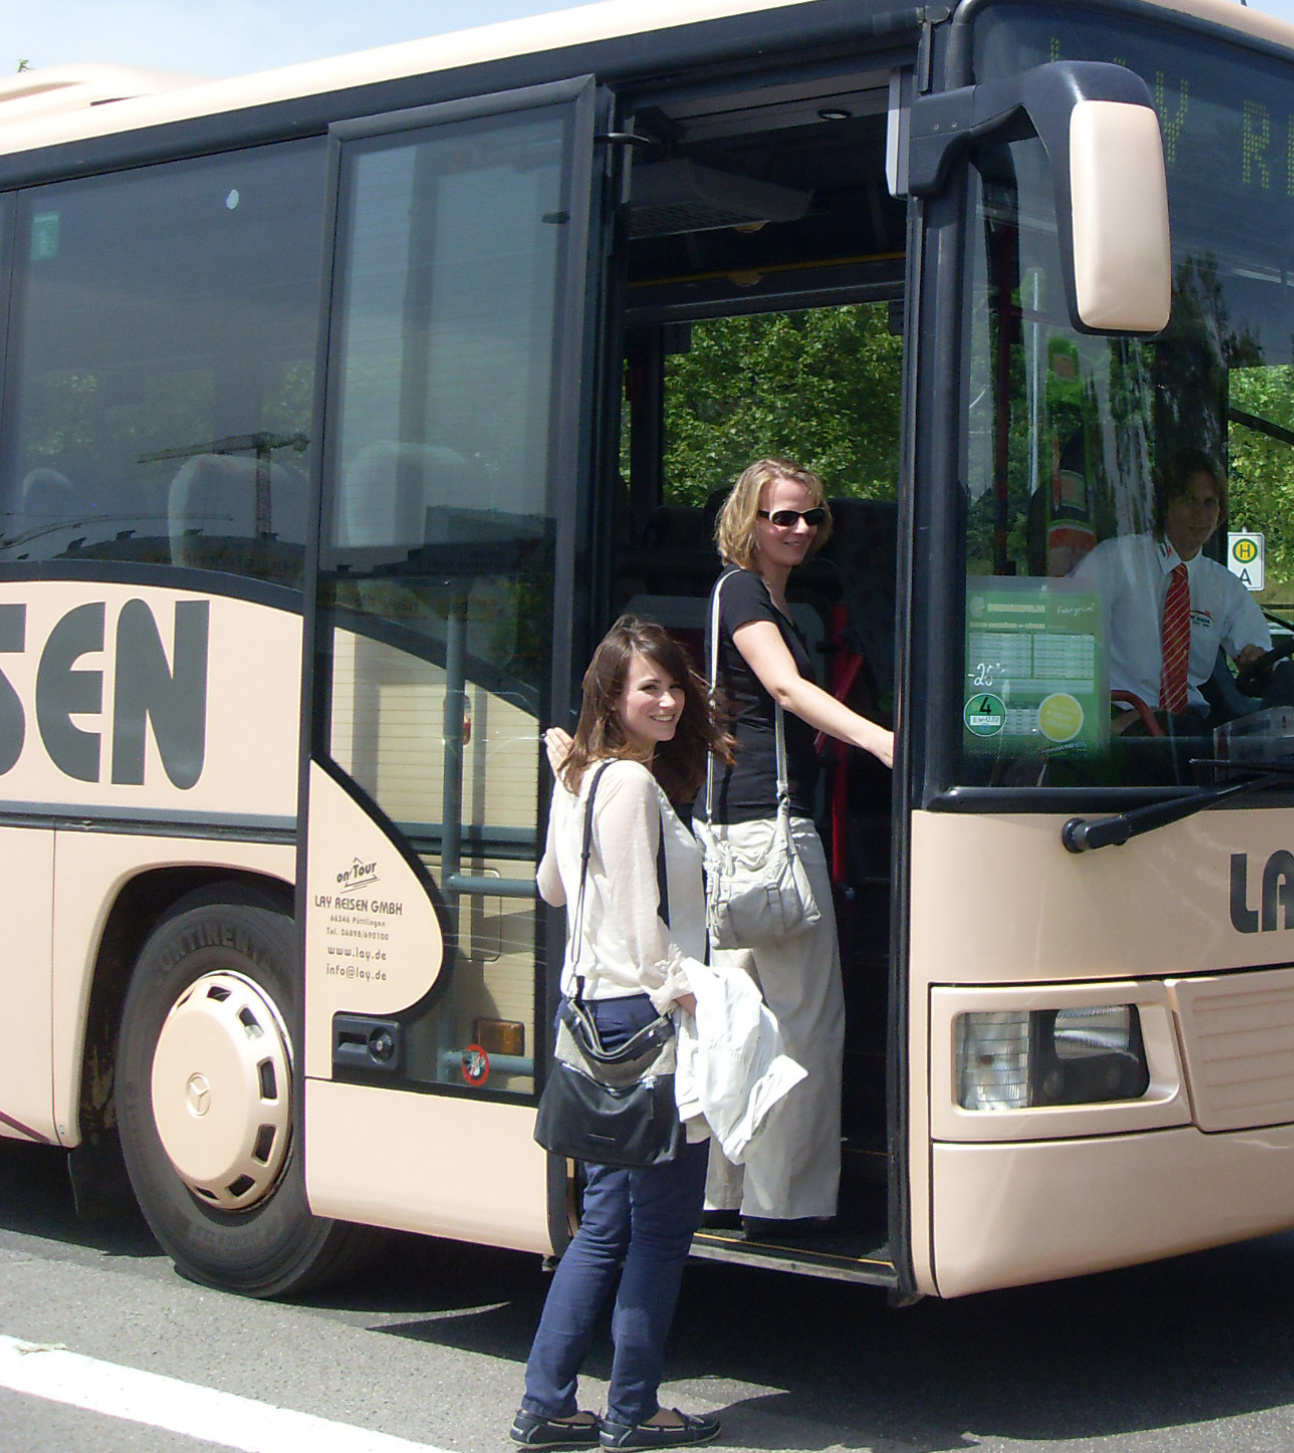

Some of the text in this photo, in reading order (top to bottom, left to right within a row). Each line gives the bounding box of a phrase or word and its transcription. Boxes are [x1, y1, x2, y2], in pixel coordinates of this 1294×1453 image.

[1240, 544, 1250, 558] H
[1240, 567, 1252, 585] A
[979, 696, 991, 716] 4
[336, 862, 377, 883] on Tour
[314, 895, 403, 916] LAY REISEN GMBH
[327, 946, 387, 962] www.lay.de
[326, 963, 387, 982] info@lay.de
